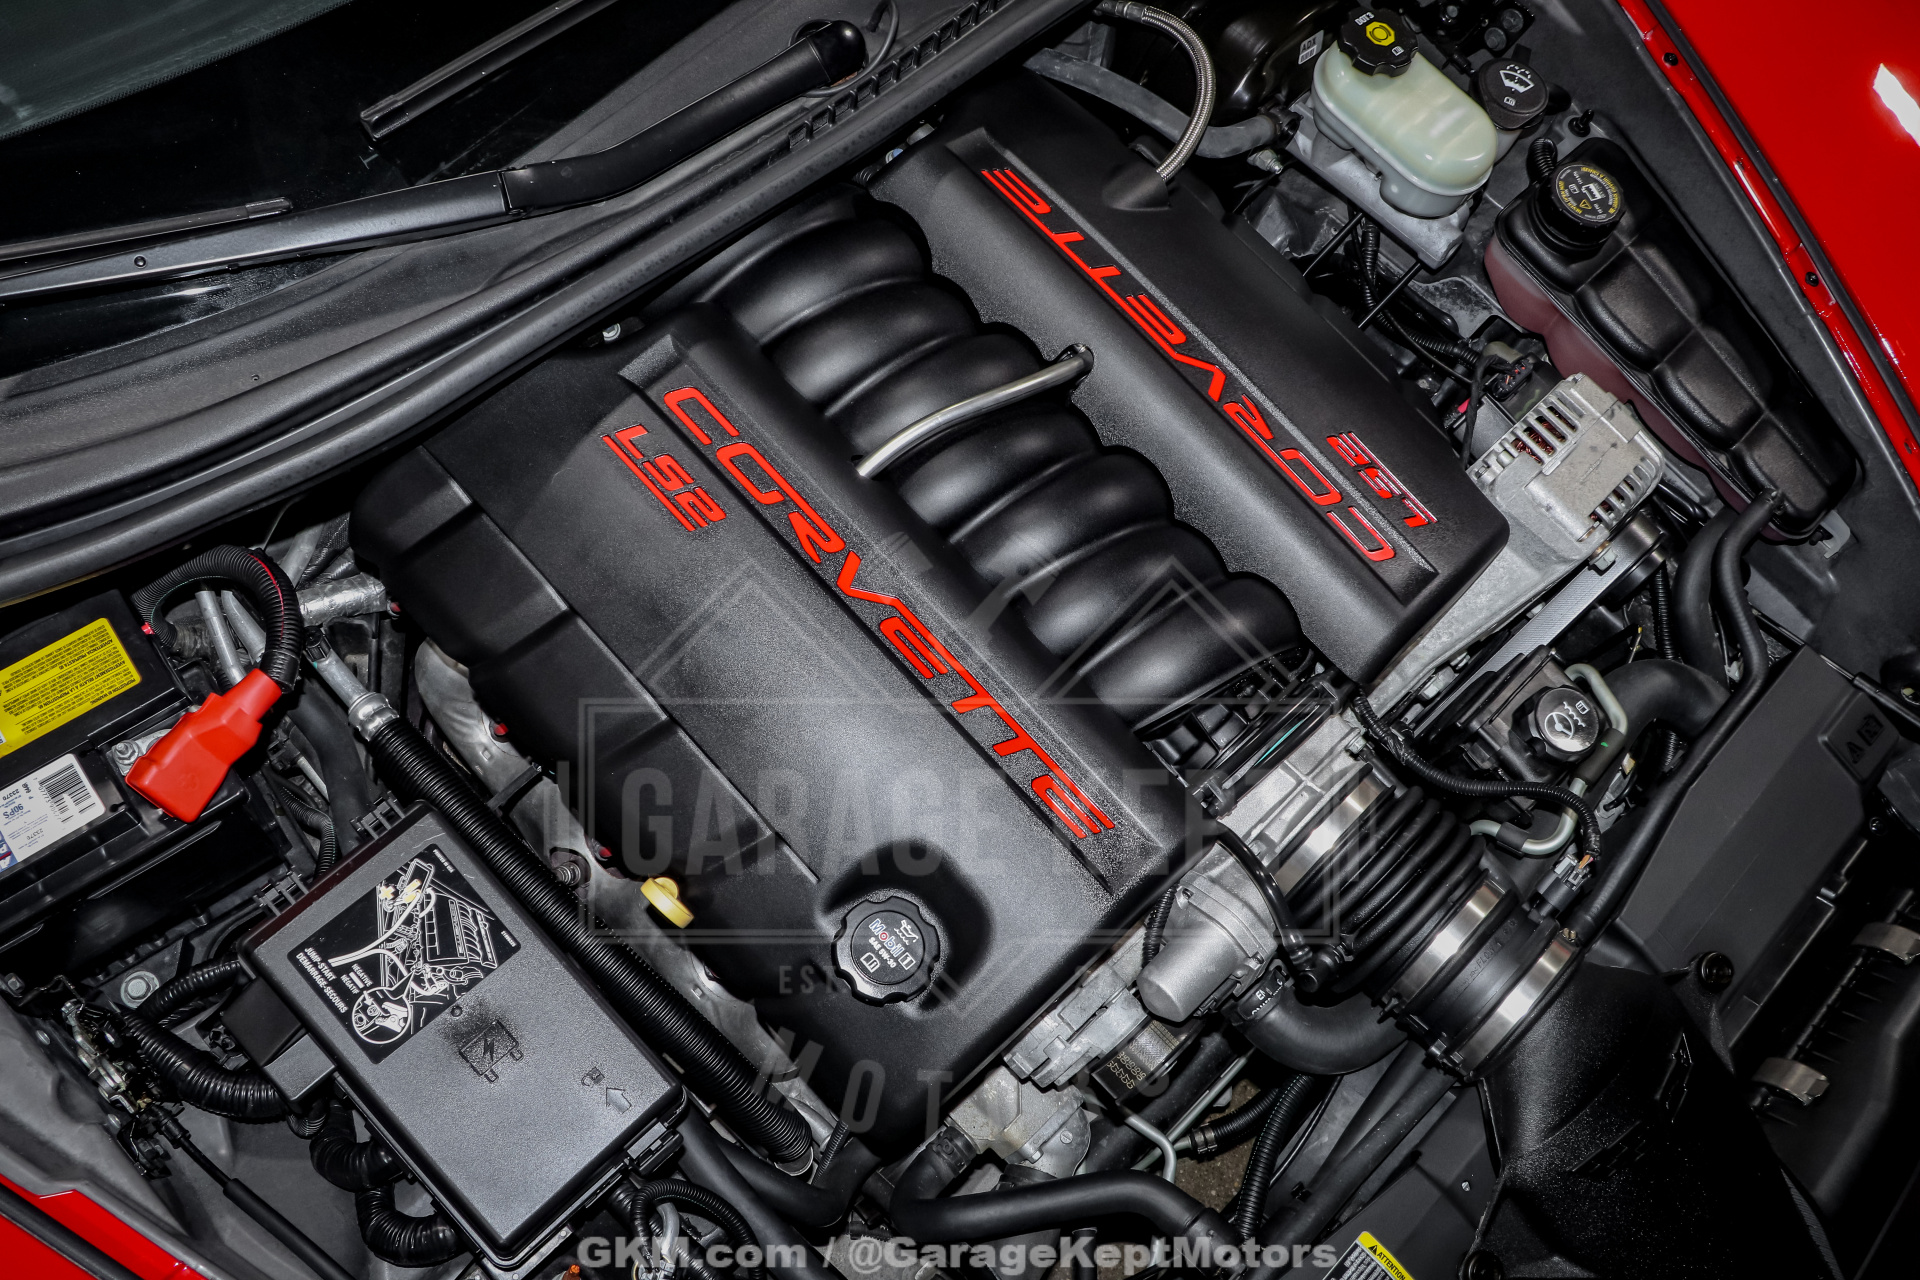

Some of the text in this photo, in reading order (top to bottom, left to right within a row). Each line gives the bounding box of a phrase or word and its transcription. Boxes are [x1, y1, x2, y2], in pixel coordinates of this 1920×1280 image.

[981, 167, 1396, 561] CORVETTE
[602, 424, 727, 531] LS2
[1327, 432, 1437, 528] LS2
[663, 387, 1115, 838] CORVETTE
[2, 803, 23, 818] 90PS
[869, 918, 905, 957] Mobil
[869, 937, 897, 968] SAE 5W-30
[304, 947, 337, 981] JUMP-START
[351, 963, 374, 987] NEGATIVE
[1377, 1252, 1406, 1280] ATTENTION
